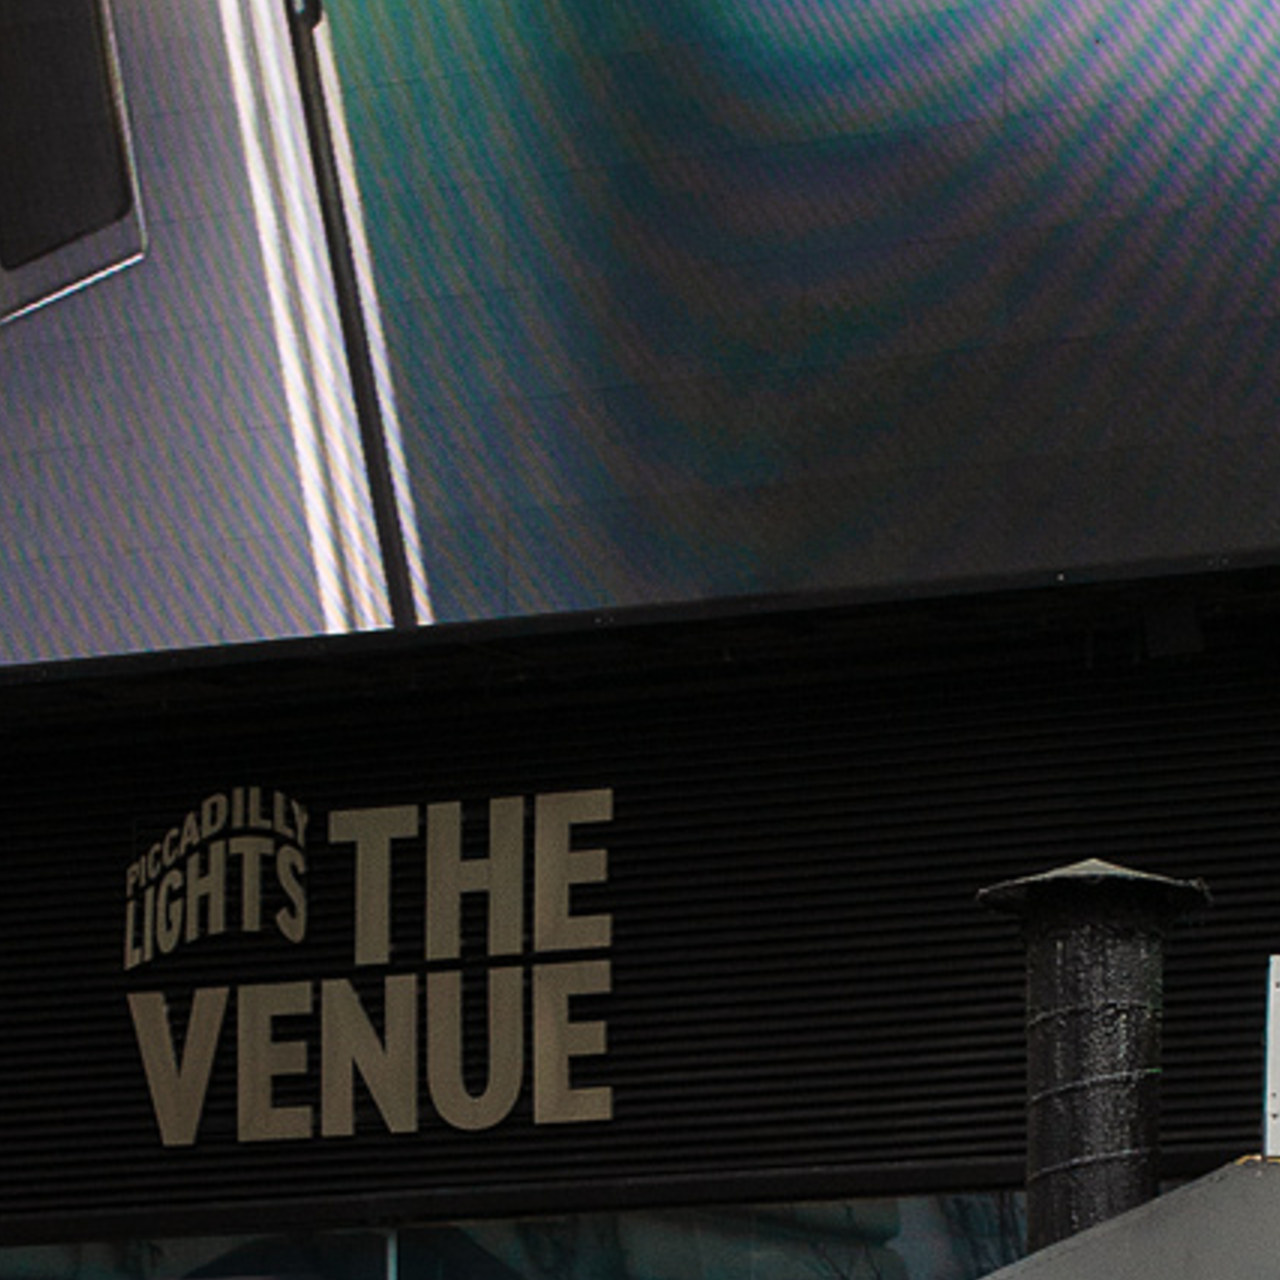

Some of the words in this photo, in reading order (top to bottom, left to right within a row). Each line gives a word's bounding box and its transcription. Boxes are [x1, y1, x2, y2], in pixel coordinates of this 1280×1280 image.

[124, 836, 307, 970] LIGHTS
[125, 787, 308, 900] PICCADILLY
[328, 788, 614, 967] THE
[126, 960, 614, 1147] VENUE
